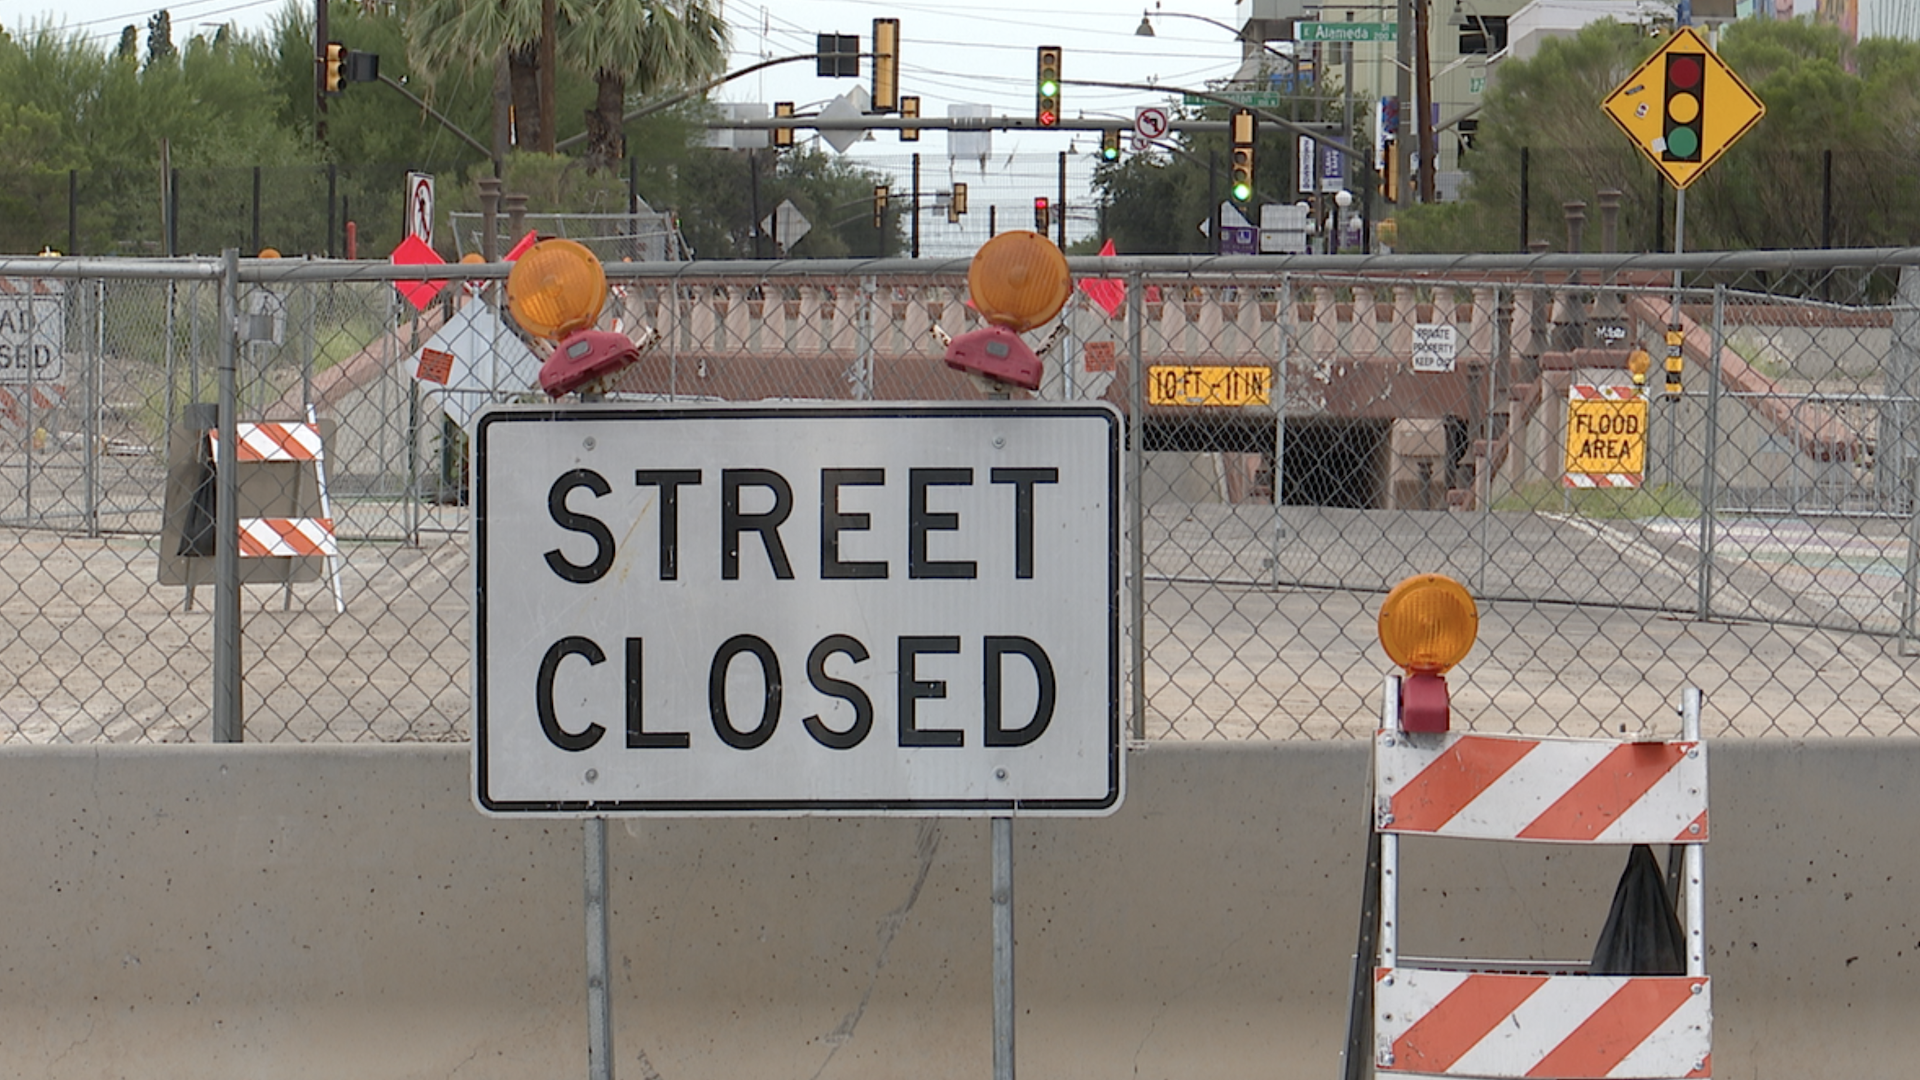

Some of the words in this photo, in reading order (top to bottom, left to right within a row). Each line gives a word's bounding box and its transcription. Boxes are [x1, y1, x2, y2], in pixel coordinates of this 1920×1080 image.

[1303, 27, 1310, 36] E
[1315, 24, 1369, 39] Alameda
[1302, 139, 1310, 189] DOWNTOWN
[1413, 342, 1454, 353] PROPERTY
[1415, 357, 1434, 366] KEEP
[1576, 414, 1638, 434] FLOOD
[1580, 439, 1631, 459] AREA
[544, 467, 1058, 583] STREET
[536, 634, 1056, 752] CLOSED
